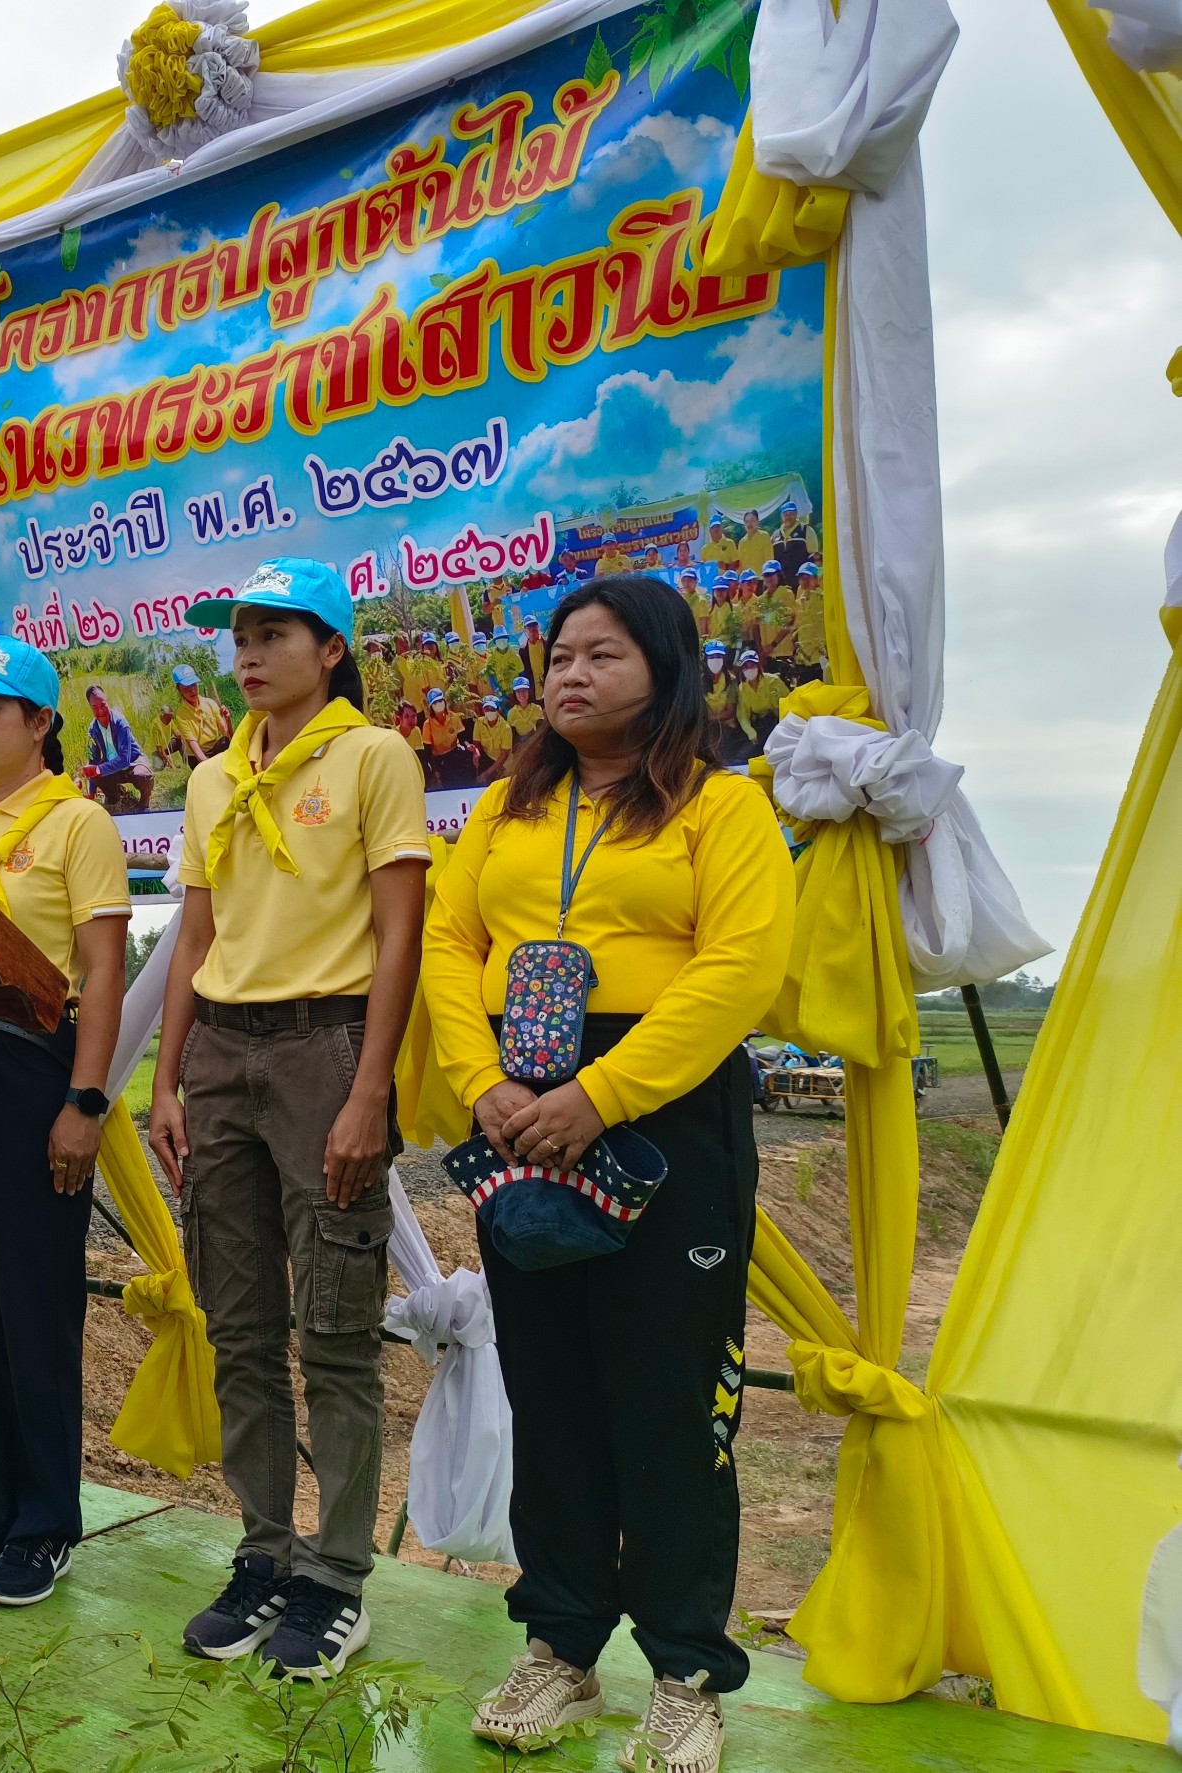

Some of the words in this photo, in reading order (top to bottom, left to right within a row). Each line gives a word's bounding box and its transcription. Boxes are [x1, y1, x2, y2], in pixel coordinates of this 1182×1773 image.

[18, 491, 166, 575] ประจำปี
[188, 480, 292, 541] พ.ศ.
[309, 422, 504, 512] ๒๕๖๗
[15, 591, 67, 650] วันที่
[72, 601, 119, 641] ๒๖
[403, 517, 548, 585] ๒๕๖๗
